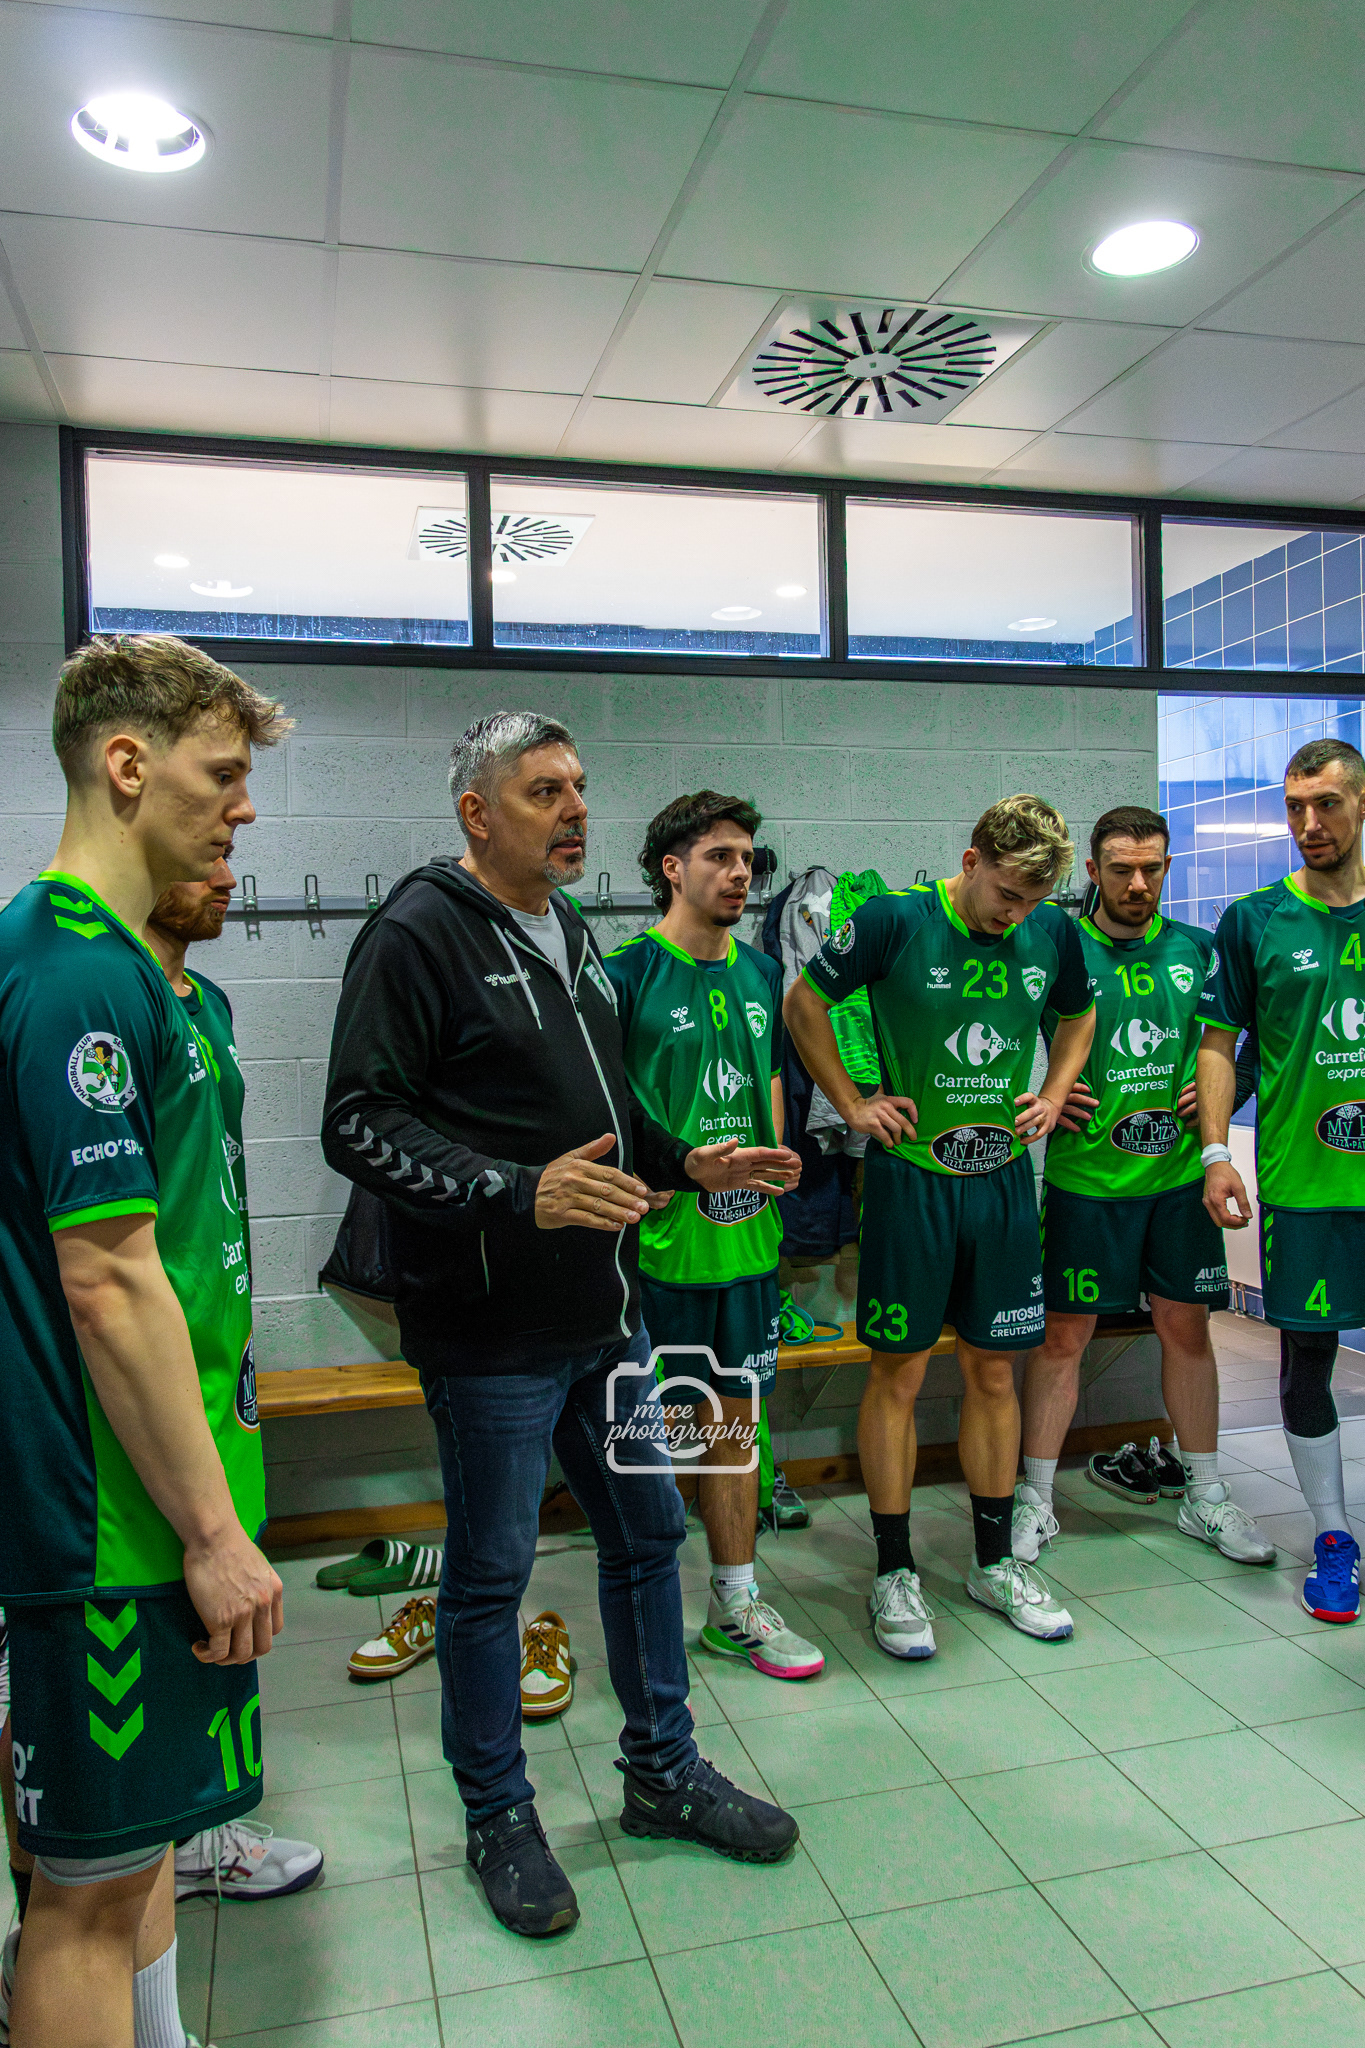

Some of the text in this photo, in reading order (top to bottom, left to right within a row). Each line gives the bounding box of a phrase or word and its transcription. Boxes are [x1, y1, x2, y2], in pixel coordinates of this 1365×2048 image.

[1340, 932, 1365, 971] 4
[816, 949, 839, 979] O'SPORT
[1293, 961, 1319, 972] hummel
[497, 968, 531, 985] humel
[962, 959, 1008, 999] 23
[1114, 962, 1154, 998] 16
[709, 989, 728, 1031] 8
[673, 1021, 695, 1033] hummel
[1149, 1027, 1180, 1040] Falck
[988, 1036, 1020, 1051] Falck
[1315, 1047, 1365, 1065] Carref
[70, 1035, 92, 1099] HANDBALL-CLUB
[1106, 1063, 1175, 1082] Carrefour
[1327, 1068, 1365, 1081] expre
[726, 1073, 754, 1087] Fack
[934, 1073, 1011, 1088] Carrefour
[1120, 1079, 1169, 1094] express
[946, 1093, 1004, 1107] express
[1121, 1125, 1144, 1146] My
[1327, 1118, 1353, 1141] My
[943, 1137, 1009, 1161] My Pizza
[1121, 1142, 1140, 1152] PIZZA
[943, 1156, 963, 1171] PIZZA
[985, 1154, 1008, 1170] SALADE
[1195, 1264, 1228, 1280] AUTO
[1062, 1268, 1099, 1303] 16
[1195, 1281, 1230, 1293] CREUTZ
[1305, 1279, 1331, 1317] 4
[865, 1298, 908, 1341] 23
[992, 1303, 1044, 1324] AUTOSUR
[990, 1320, 1045, 1338] CREUTZWALD
[207, 1693, 263, 1792] 10
